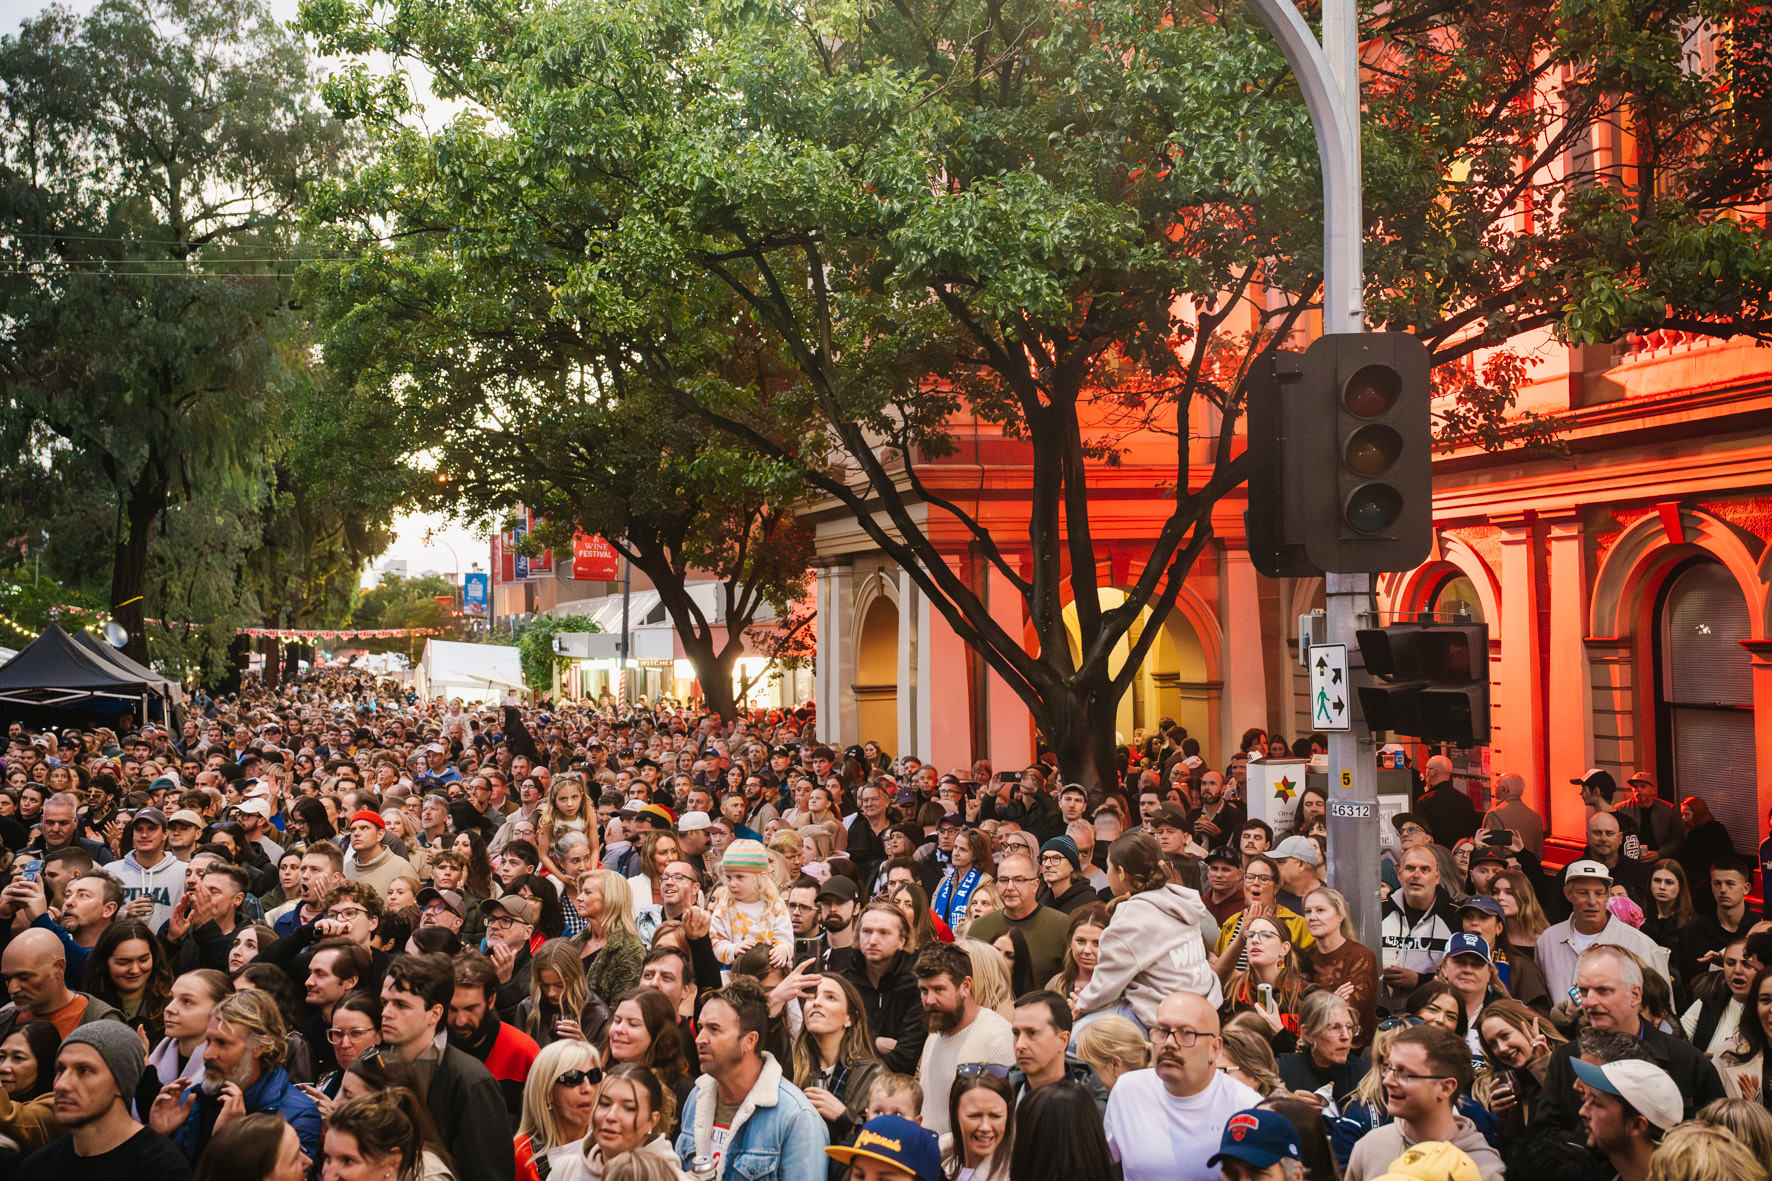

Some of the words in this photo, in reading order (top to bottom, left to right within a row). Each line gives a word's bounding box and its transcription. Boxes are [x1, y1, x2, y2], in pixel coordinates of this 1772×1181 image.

[579, 550, 612, 558] FESTIVAL
[1342, 773, 1351, 786] 5
[1332, 804, 1369, 817] 46312
